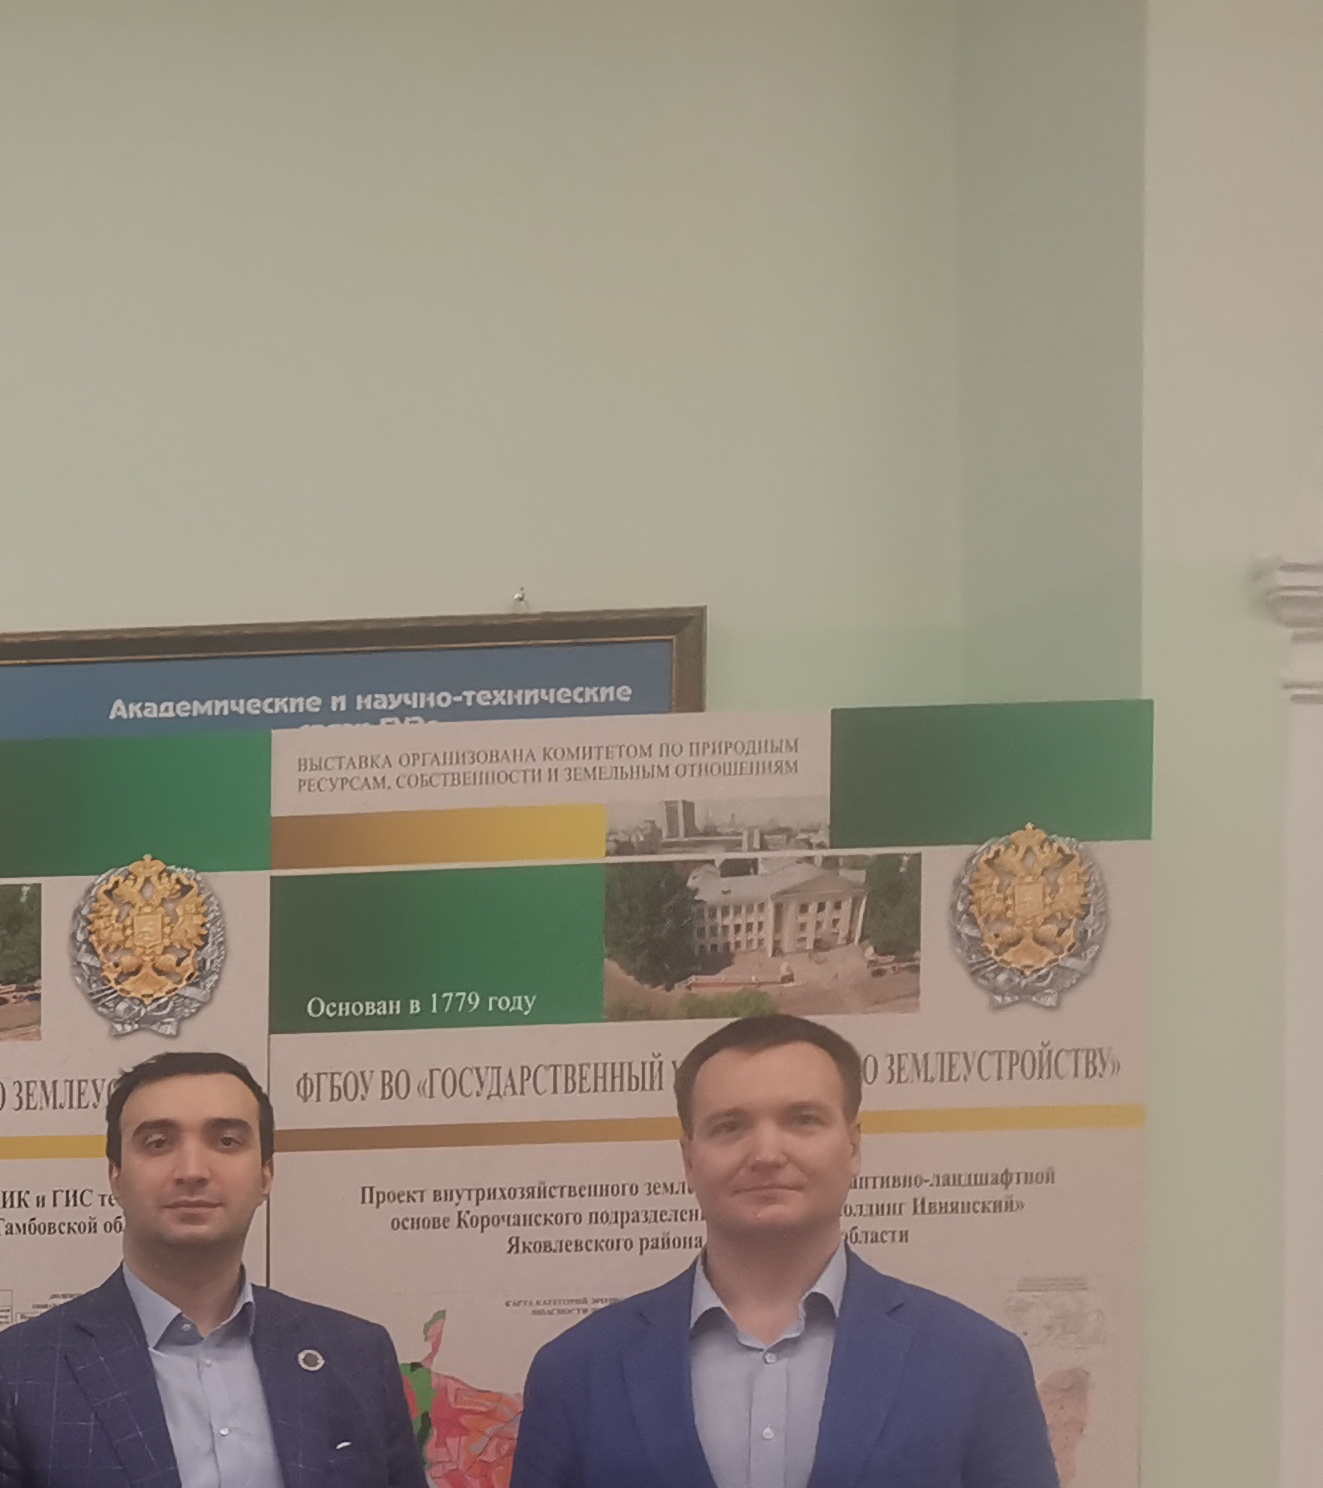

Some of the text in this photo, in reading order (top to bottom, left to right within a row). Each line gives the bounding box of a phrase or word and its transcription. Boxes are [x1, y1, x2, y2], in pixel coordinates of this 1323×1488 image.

[109, 684, 632, 721] Академические и научно-технические
[298, 739, 799, 772] ВЫСТАВКА ОРГАНИЗОВАНА КОМИТЕТОМ ПО ПРИРОДНЫМ
[396, 769, 542, 789] СОБСТВЕННОСТИ
[548, 768, 559, 783] И
[564, 763, 670, 782] ЗЕМЕЛЬНЫМ
[675, 760, 799, 778] ОТНОШЕНИЯМ
[307, 992, 537, 1018] Основан в 1779 году
[887, 1041, 1121, 1084] ЗЕМЛЕУСТРОЙСТВУ»
[296, 1072, 373, 1102] ФГБОУ
[381, 1071, 410, 1100] ВО
[417, 1053, 664, 1100] «ГОСУДАРСТВЕННЫЙ
[1, 1191, 31, 1208] ИК
[37, 1195, 46, 1207] и
[52, 1189, 93, 1207] ГИС
[360, 1179, 639, 1208] Проект внутрихозяйственного
[391, 1210, 582, 1232] основе Корочанского
[506, 1234, 703, 1254] Яковлевского района
